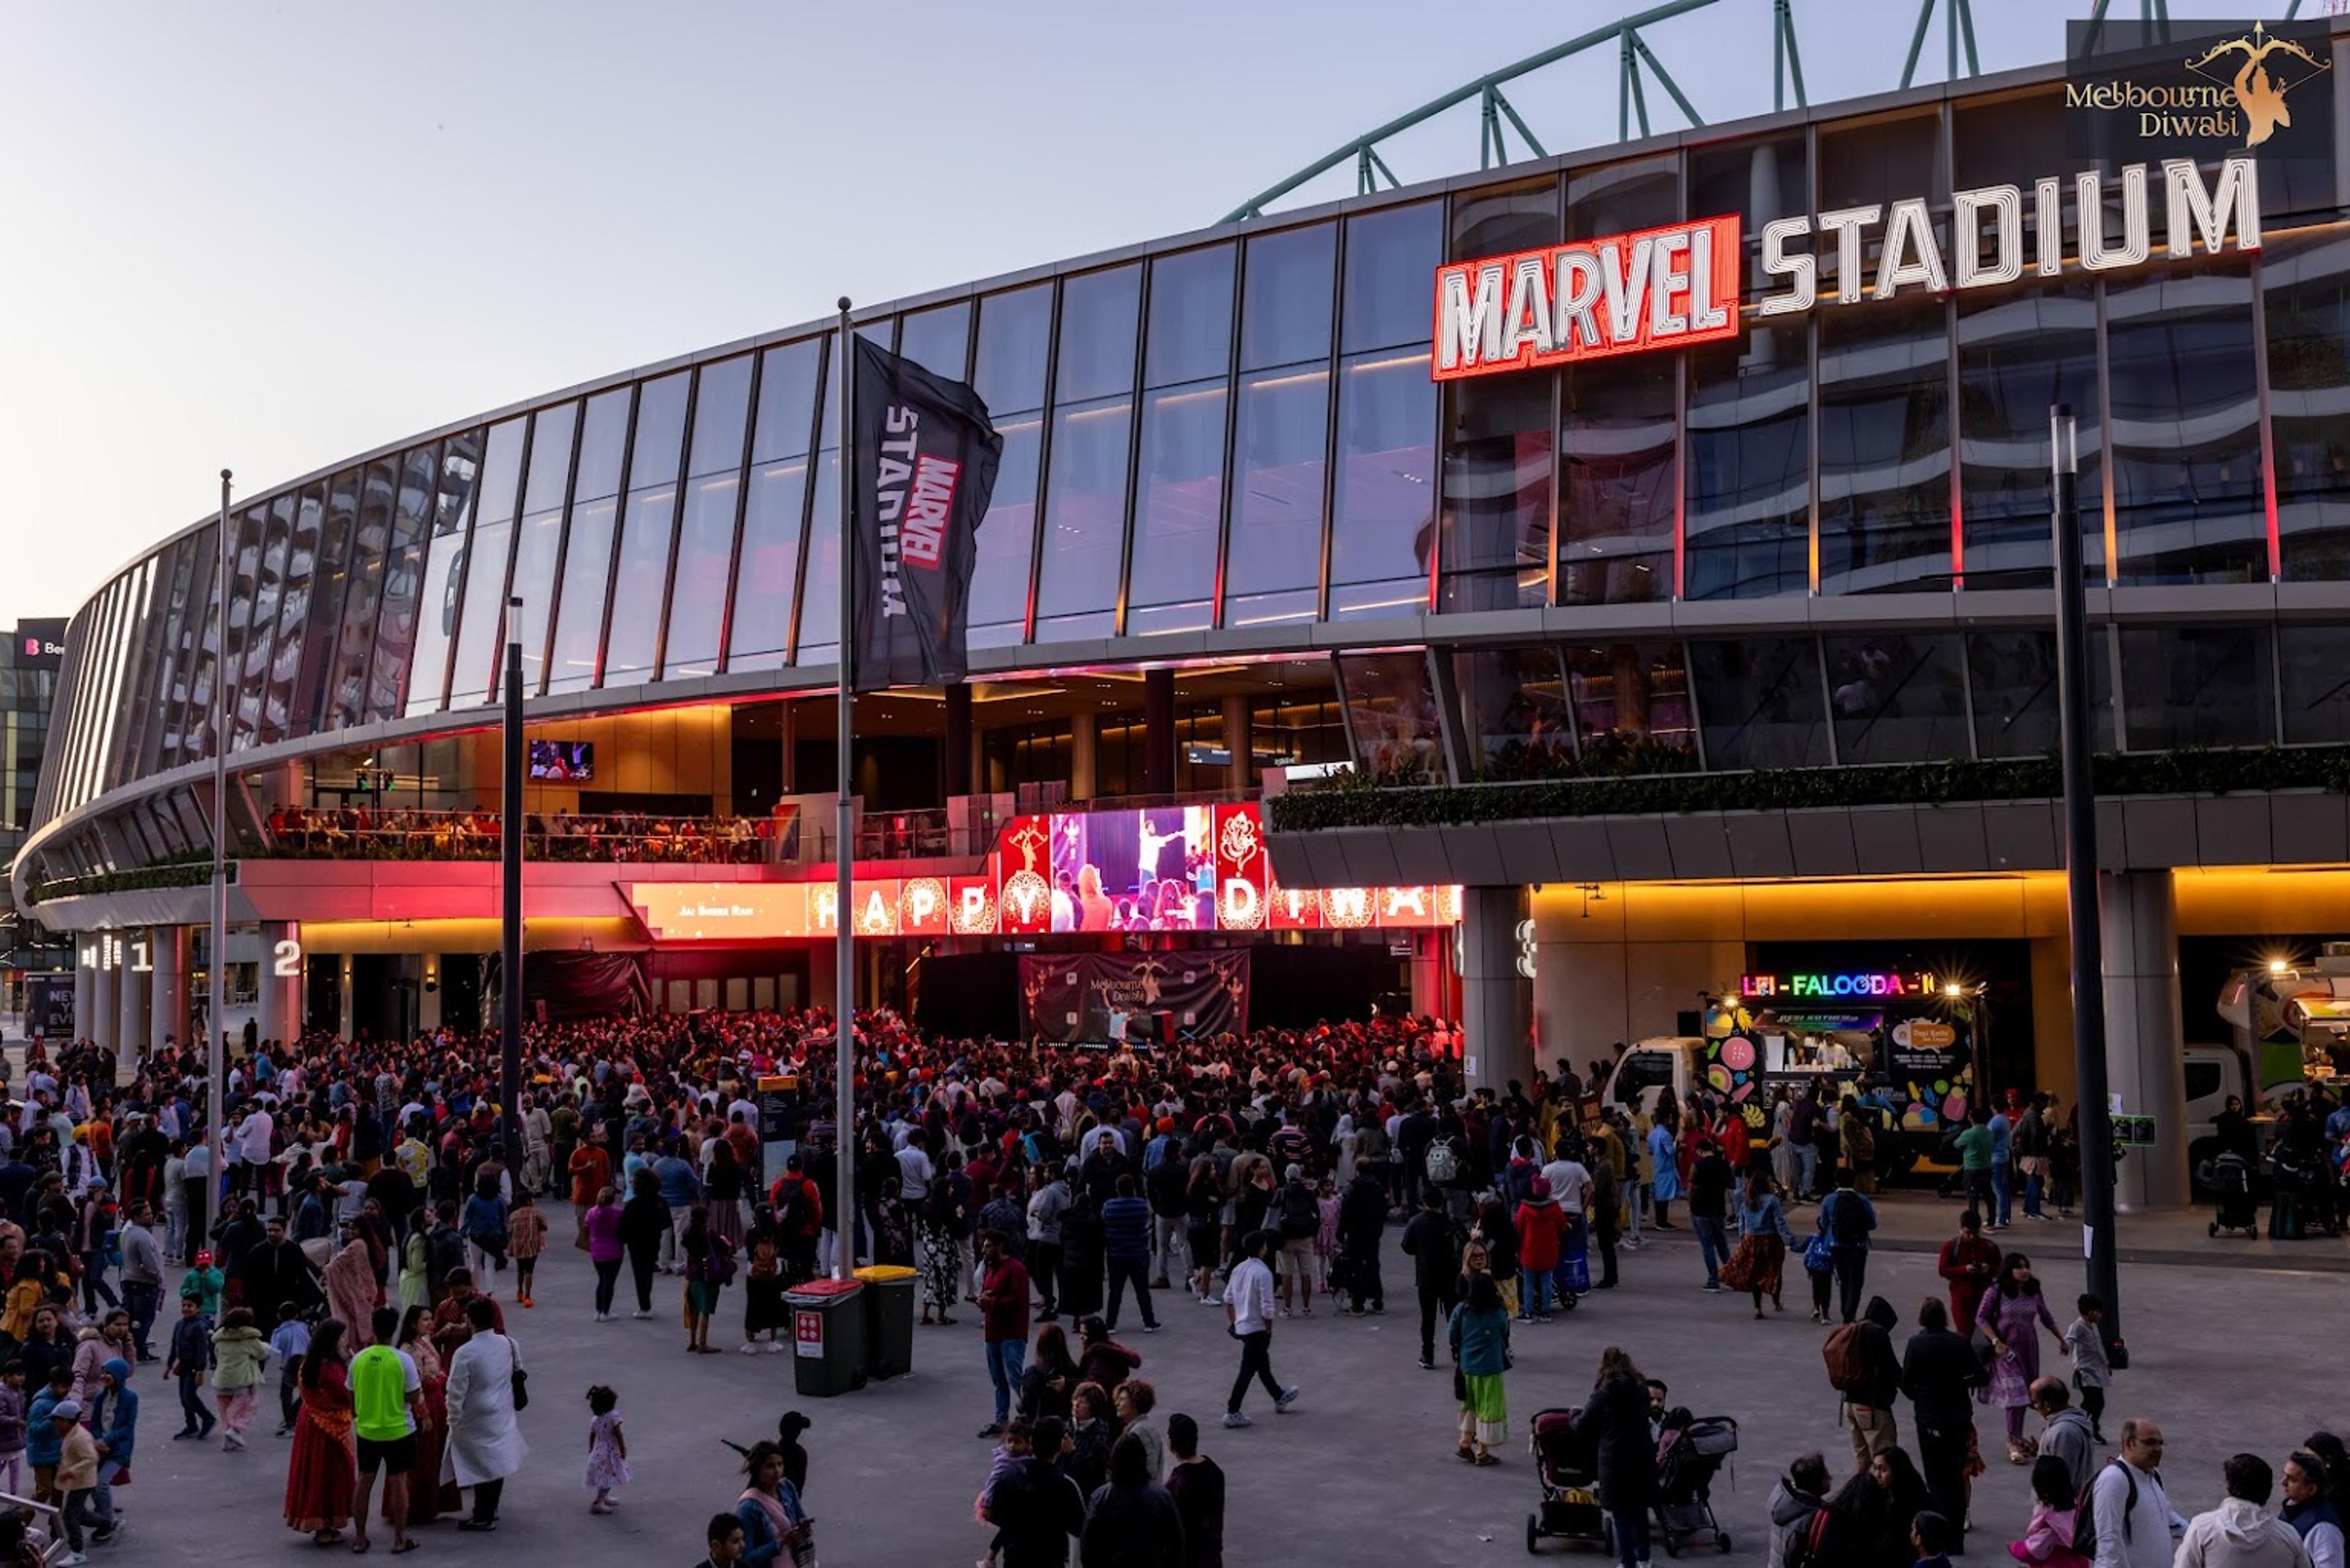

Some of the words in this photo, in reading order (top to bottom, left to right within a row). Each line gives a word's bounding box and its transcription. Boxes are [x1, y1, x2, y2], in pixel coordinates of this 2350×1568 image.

[1441, 226, 1728, 368] MARVEL
[1758, 150, 2262, 316] STADIUM
[901, 457, 959, 563] MARVEL
[818, 886, 1038, 929] HAPPY
[131, 942, 154, 972] 1
[274, 939, 300, 977] 2
[1792, 974, 1906, 996] FALOODA
